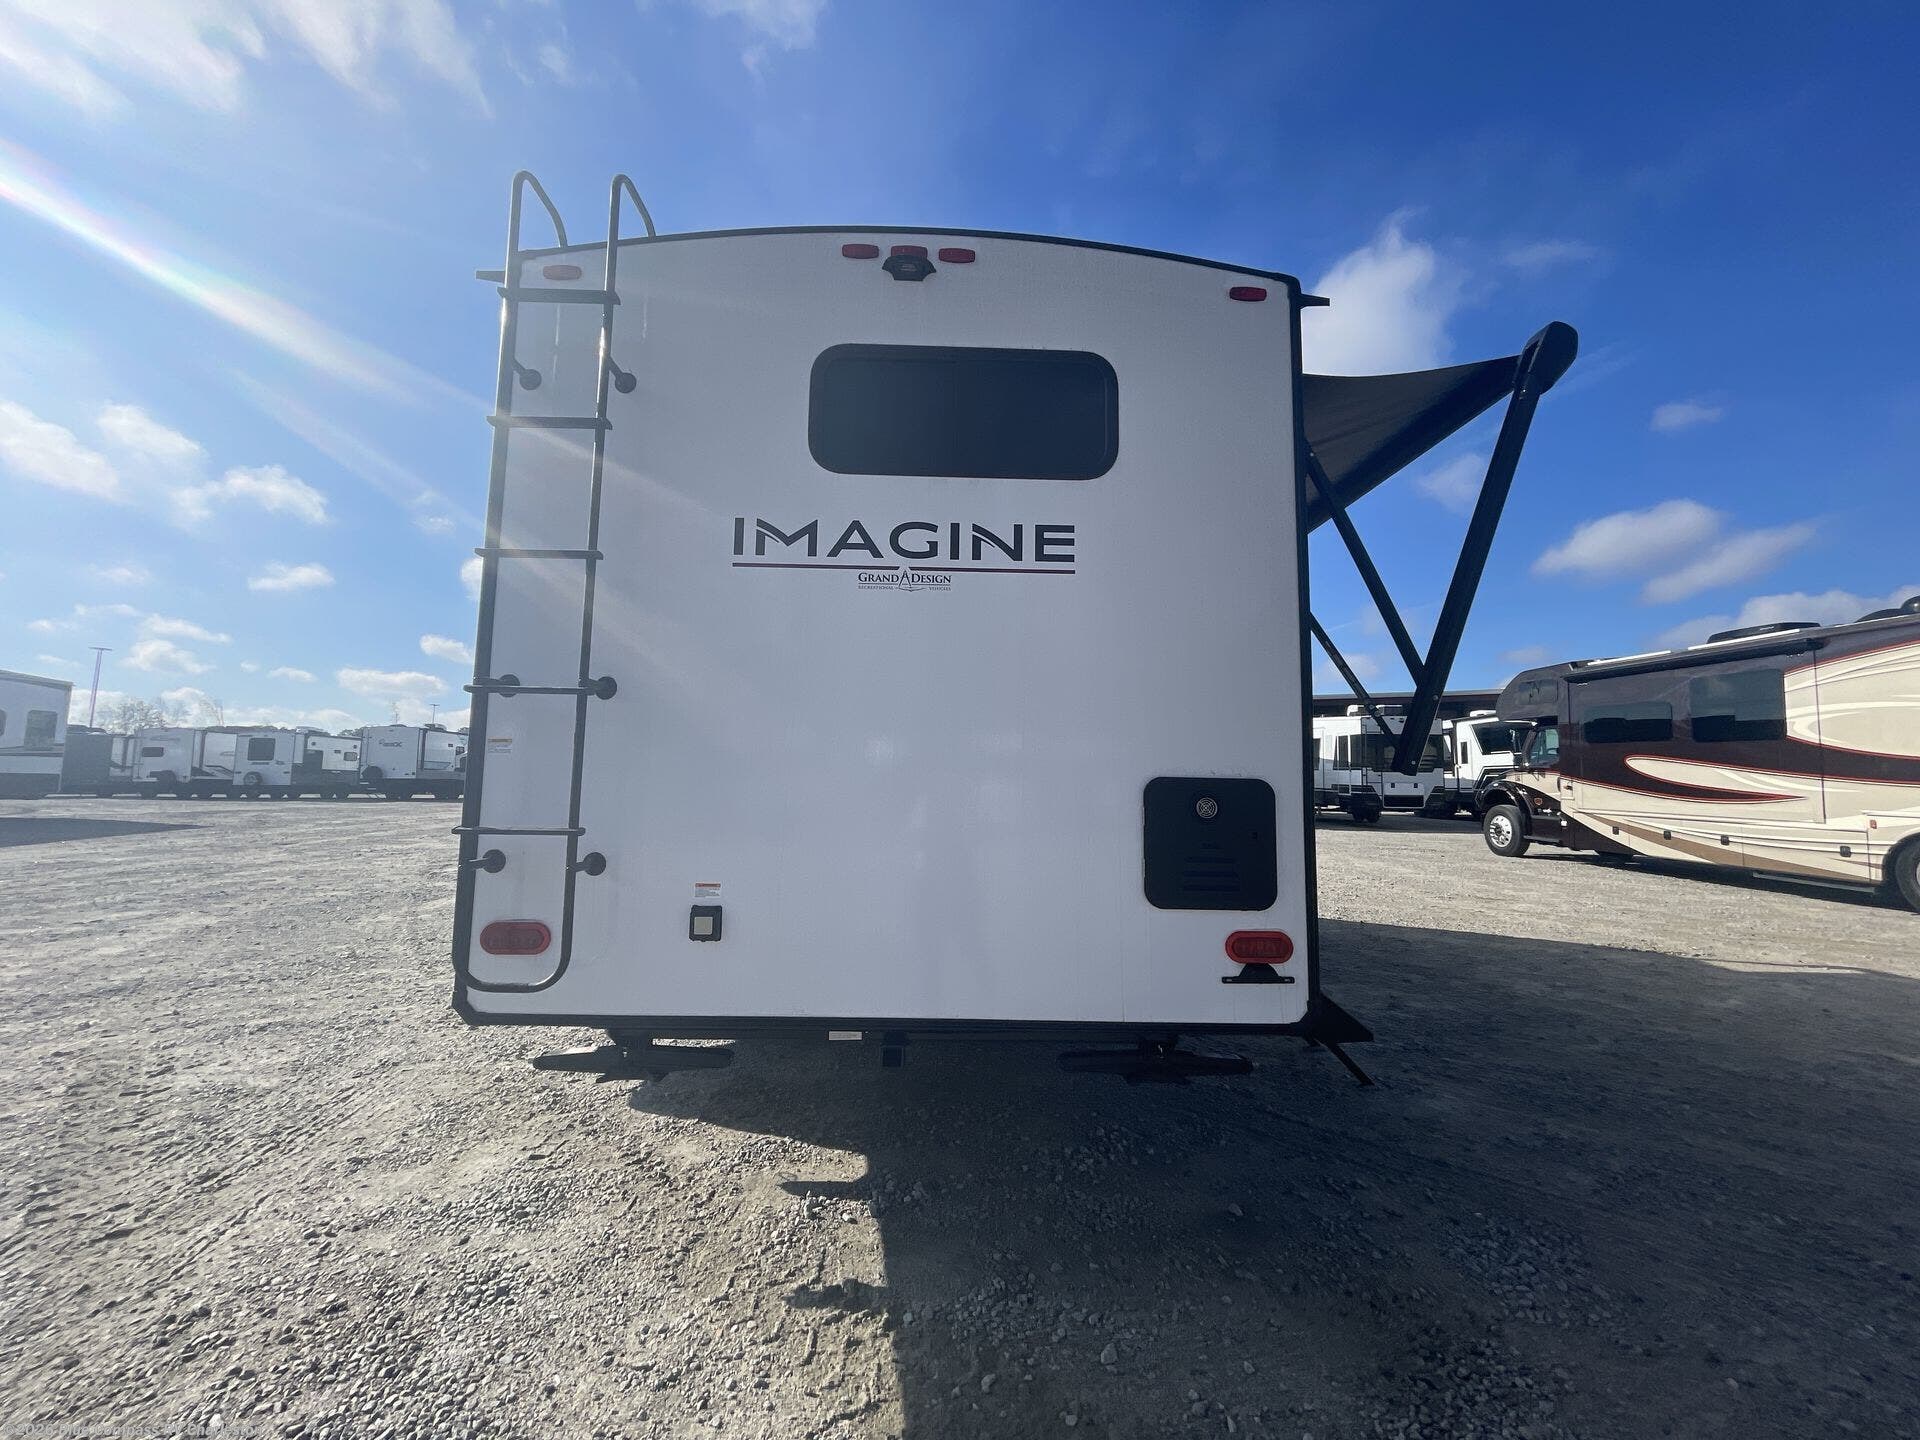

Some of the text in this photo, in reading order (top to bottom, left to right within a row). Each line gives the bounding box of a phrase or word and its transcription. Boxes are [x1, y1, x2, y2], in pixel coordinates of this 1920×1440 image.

[733, 517, 1075, 562] IMAGINE
[858, 572, 951, 584] GRAND DESIGN
